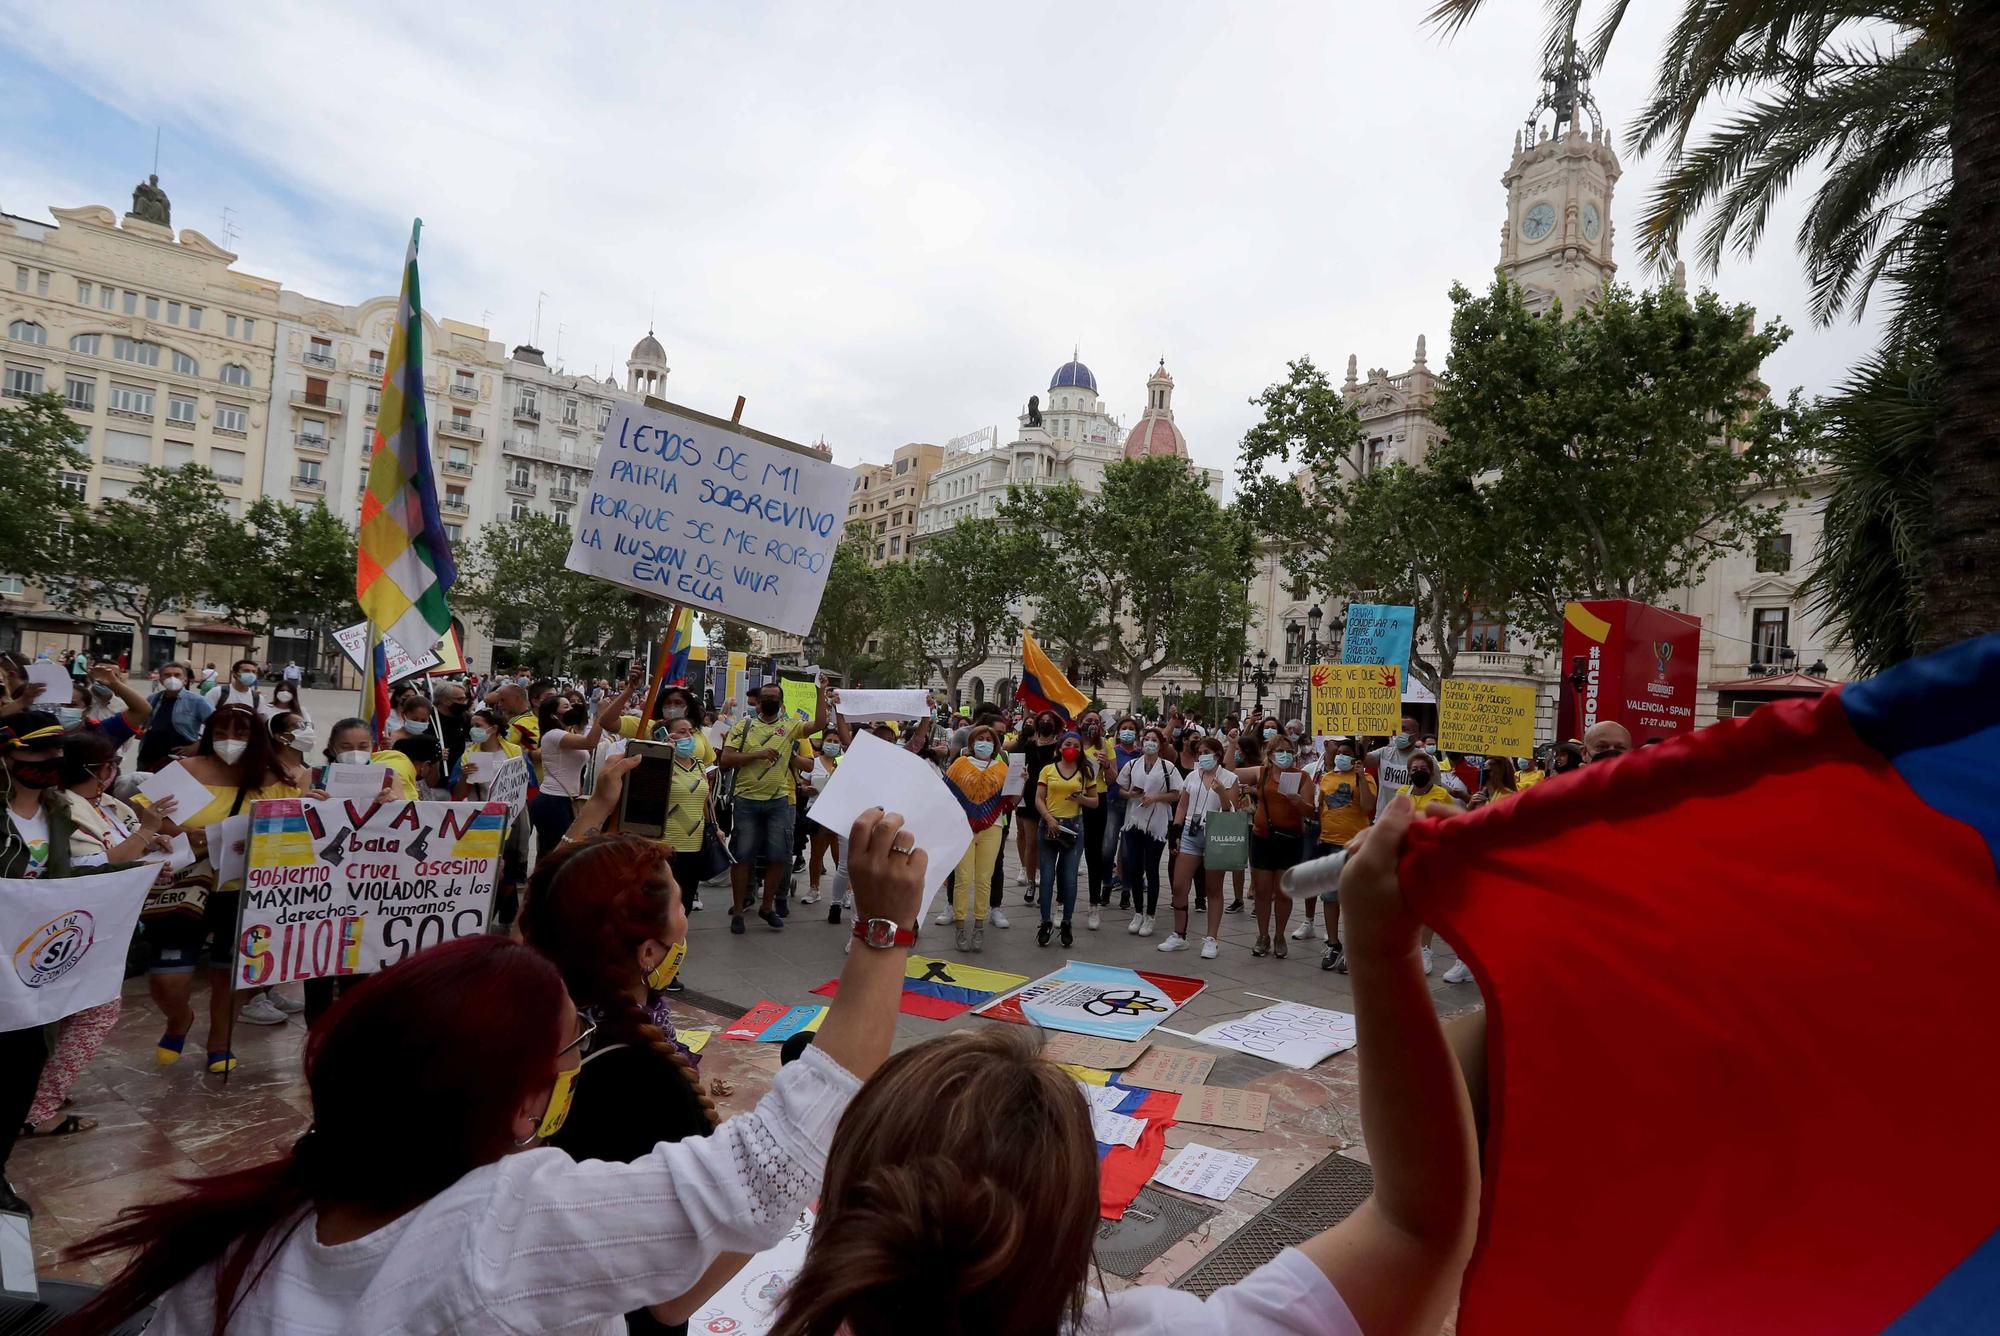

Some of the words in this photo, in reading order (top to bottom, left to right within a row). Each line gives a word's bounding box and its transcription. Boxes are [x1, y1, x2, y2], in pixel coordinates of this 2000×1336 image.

[619, 417, 701, 466] LEJOS
[712, 446, 749, 481] DE
[761, 463, 800, 495] MI
[609, 460, 678, 494] PATRIA
[698, 478, 835, 537] SOBREVIVO
[590, 492, 674, 532] PORQUE
[683, 519, 716, 544] SE
[722, 528, 757, 555] ME
[765, 538, 825, 573] ROBO
[580, 528, 602, 550] LA
[614, 533, 687, 570] ILUSION
[695, 554, 724, 580] DE
[733, 566, 780, 595] VIVIR
[632, 562, 671, 586] EN
[677, 574, 724, 602] ELLA
[1390, 620, 1398, 629] A
[1373, 628, 1385, 637] NO
[1331, 669, 1342, 680] SE
[1346, 669, 1357, 680] VE
[1361, 669, 1376, 680] QUE
[1316, 686, 1342, 699] MATAR
[1345, 687, 1355, 699] NO
[1358, 686, 1366, 699] ES
[1444, 680, 1465, 690] COMO
[1467, 683, 1479, 692] ASI
[1482, 684, 1497, 693] QUE
[1316, 702, 1348, 716] CUANDO
[1352, 702, 1361, 715] EL
[1362, 702, 1395, 715] ASESINO
[1442, 711, 1451, 720] ES
[1514, 708, 1525, 717] NO
[1626, 700, 1664, 713] VALENCIA
[1669, 706, 1691, 717] SPAIN
[1327, 717, 1339, 732] ES
[1342, 717, 1353, 732] EL
[1358, 717, 1388, 732] ESTADO
[1640, 717, 1658, 726] 17-27
[1659, 719, 1677, 728] JUNIO
[1489, 735, 1497, 745] SE
[1211, 835, 1246, 843] PULL&BEAR
[248, 864, 331, 889] gobierno
[414, 858, 488, 877] asesino
[247, 882, 332, 909] MÁXIMO
[347, 879, 440, 902] VIOLADOR
[443, 878, 463, 898] de
[469, 876, 492, 896] los
[275, 902, 357, 925] derechos
[377, 900, 456, 917] humanos
